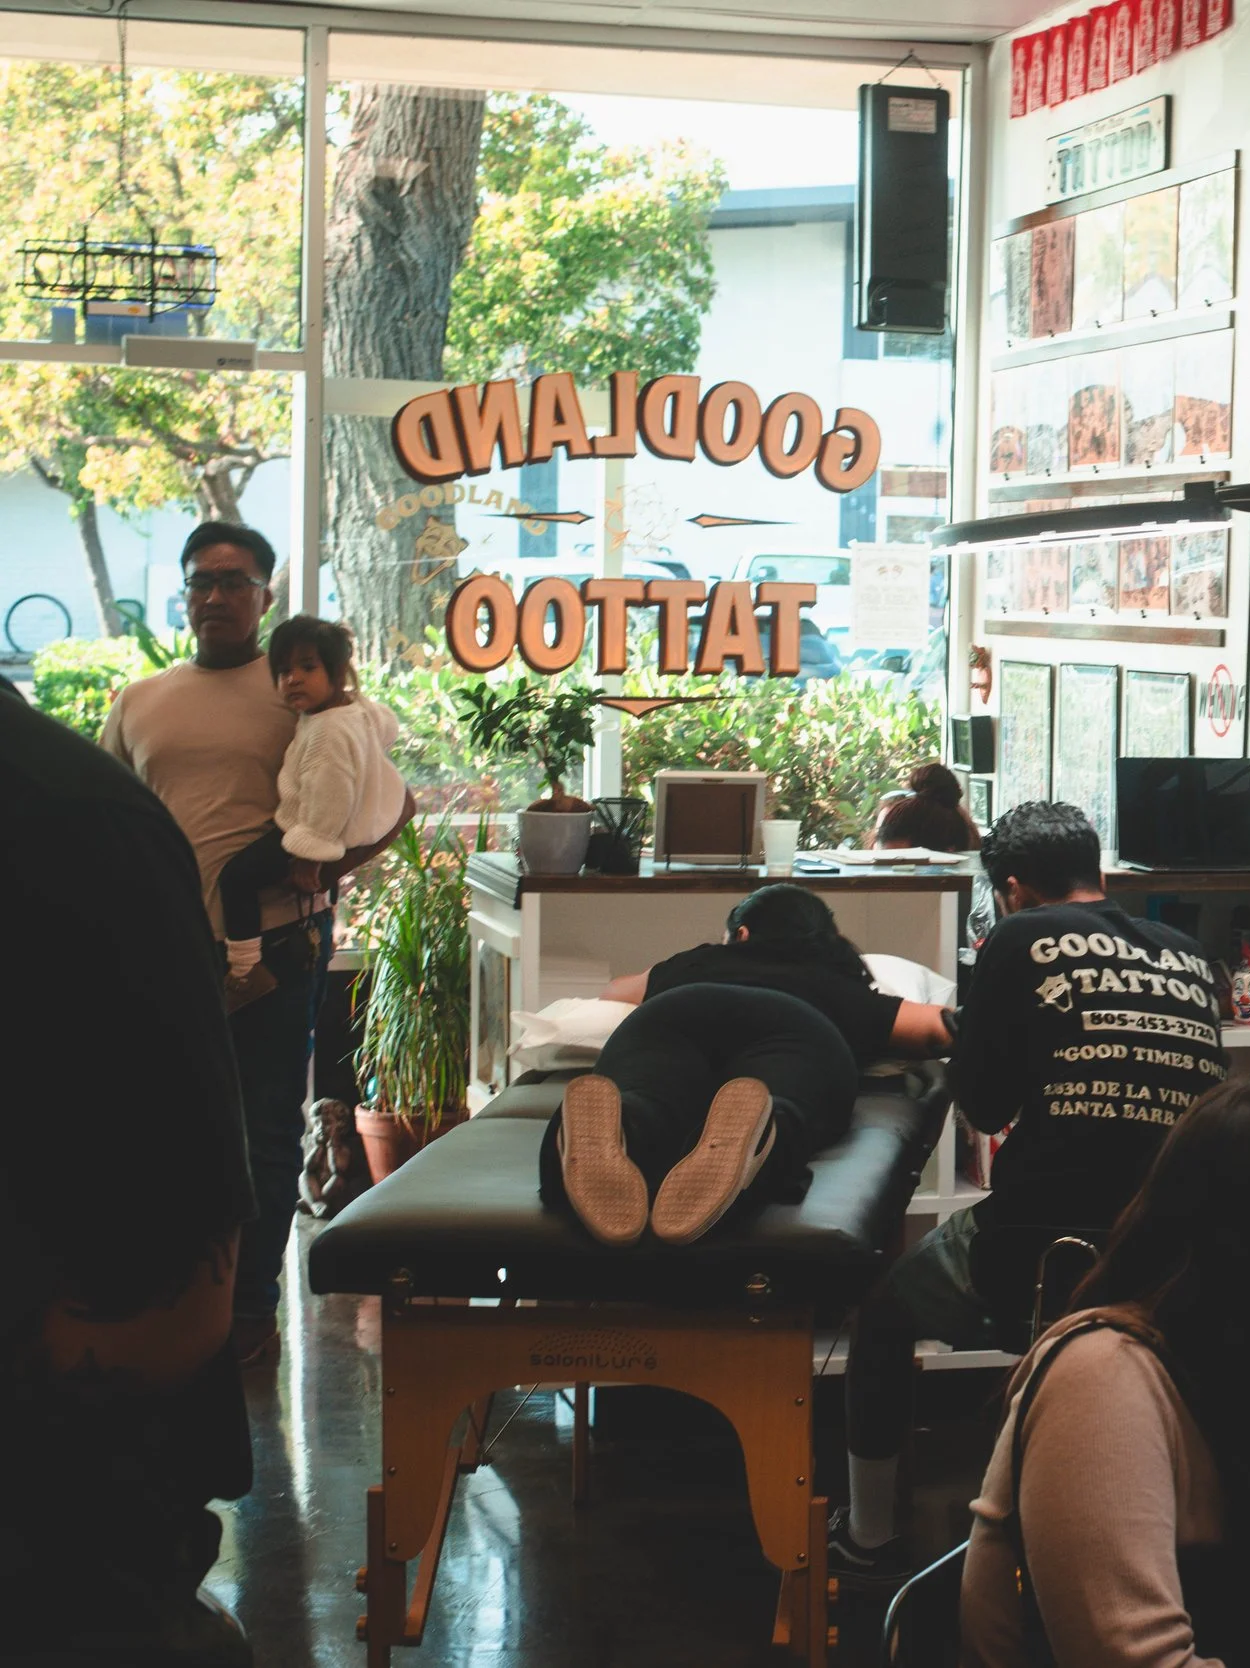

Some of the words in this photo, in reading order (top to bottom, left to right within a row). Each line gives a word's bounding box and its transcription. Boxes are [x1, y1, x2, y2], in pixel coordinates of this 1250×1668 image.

[376, 483, 548, 537] GOODLAND
[1072, 968, 1208, 1008] TATTOO
[1133, 1046, 1194, 1070] TIMES
[1199, 1059, 1228, 1081] ONL
[1092, 1081, 1120, 1097] DE
[1126, 1083, 1152, 1100] LA
[1049, 1101, 1117, 1118] SANTA
[530, 1353, 657, 1370] saloniture
